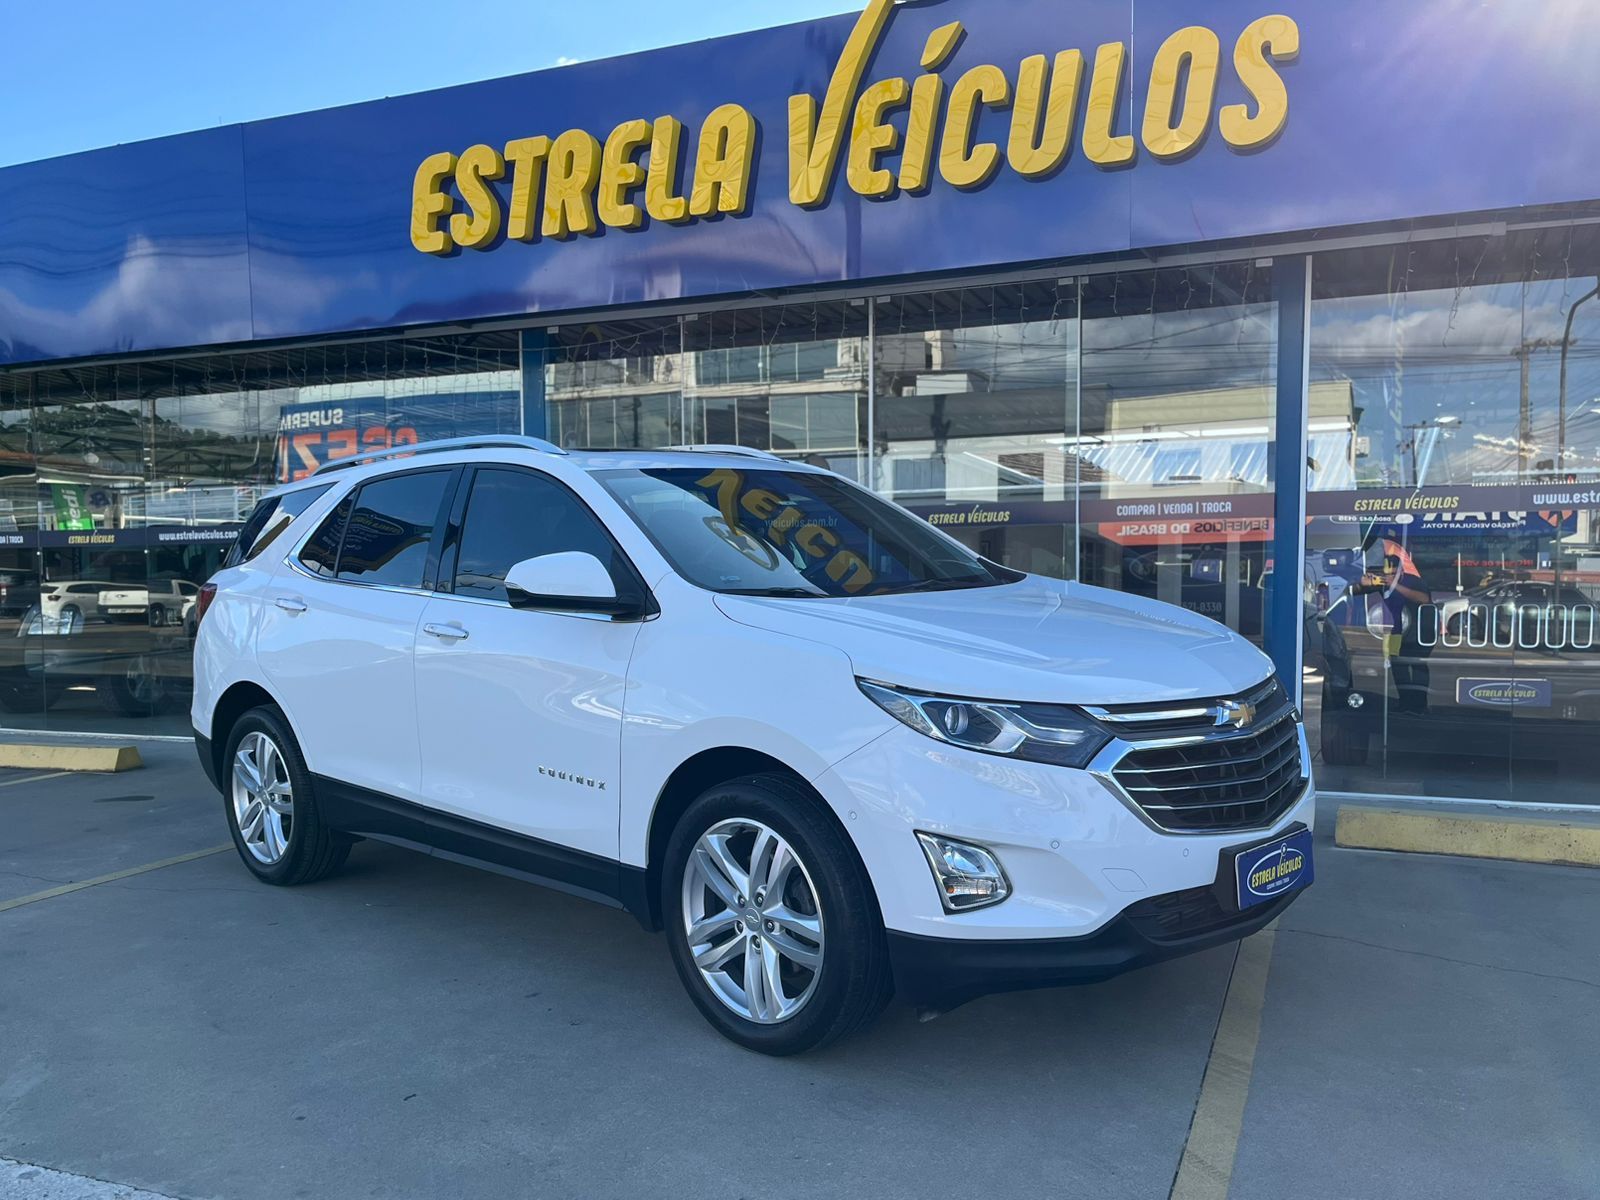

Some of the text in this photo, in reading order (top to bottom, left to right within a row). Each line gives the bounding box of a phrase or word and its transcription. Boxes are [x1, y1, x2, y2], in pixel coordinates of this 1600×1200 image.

[410, 0, 1299, 254] ESTRELA VEÍCULOS
[1116, 503, 1156, 516] COMPRA
[1163, 503, 1193, 514] VENDA
[1201, 501, 1232, 513] TROCA
[1354, 489, 1459, 511] ESTRELA VEÍCULOS
[928, 504, 1011, 525] ESTRELA VEÍCULOS
[68, 535, 90, 544] ESTRELA
[1474, 689, 1502, 697] ESTRELA
[538, 765, 606, 790] EQUINOX
[1251, 866, 1275, 888] ESTRELA
